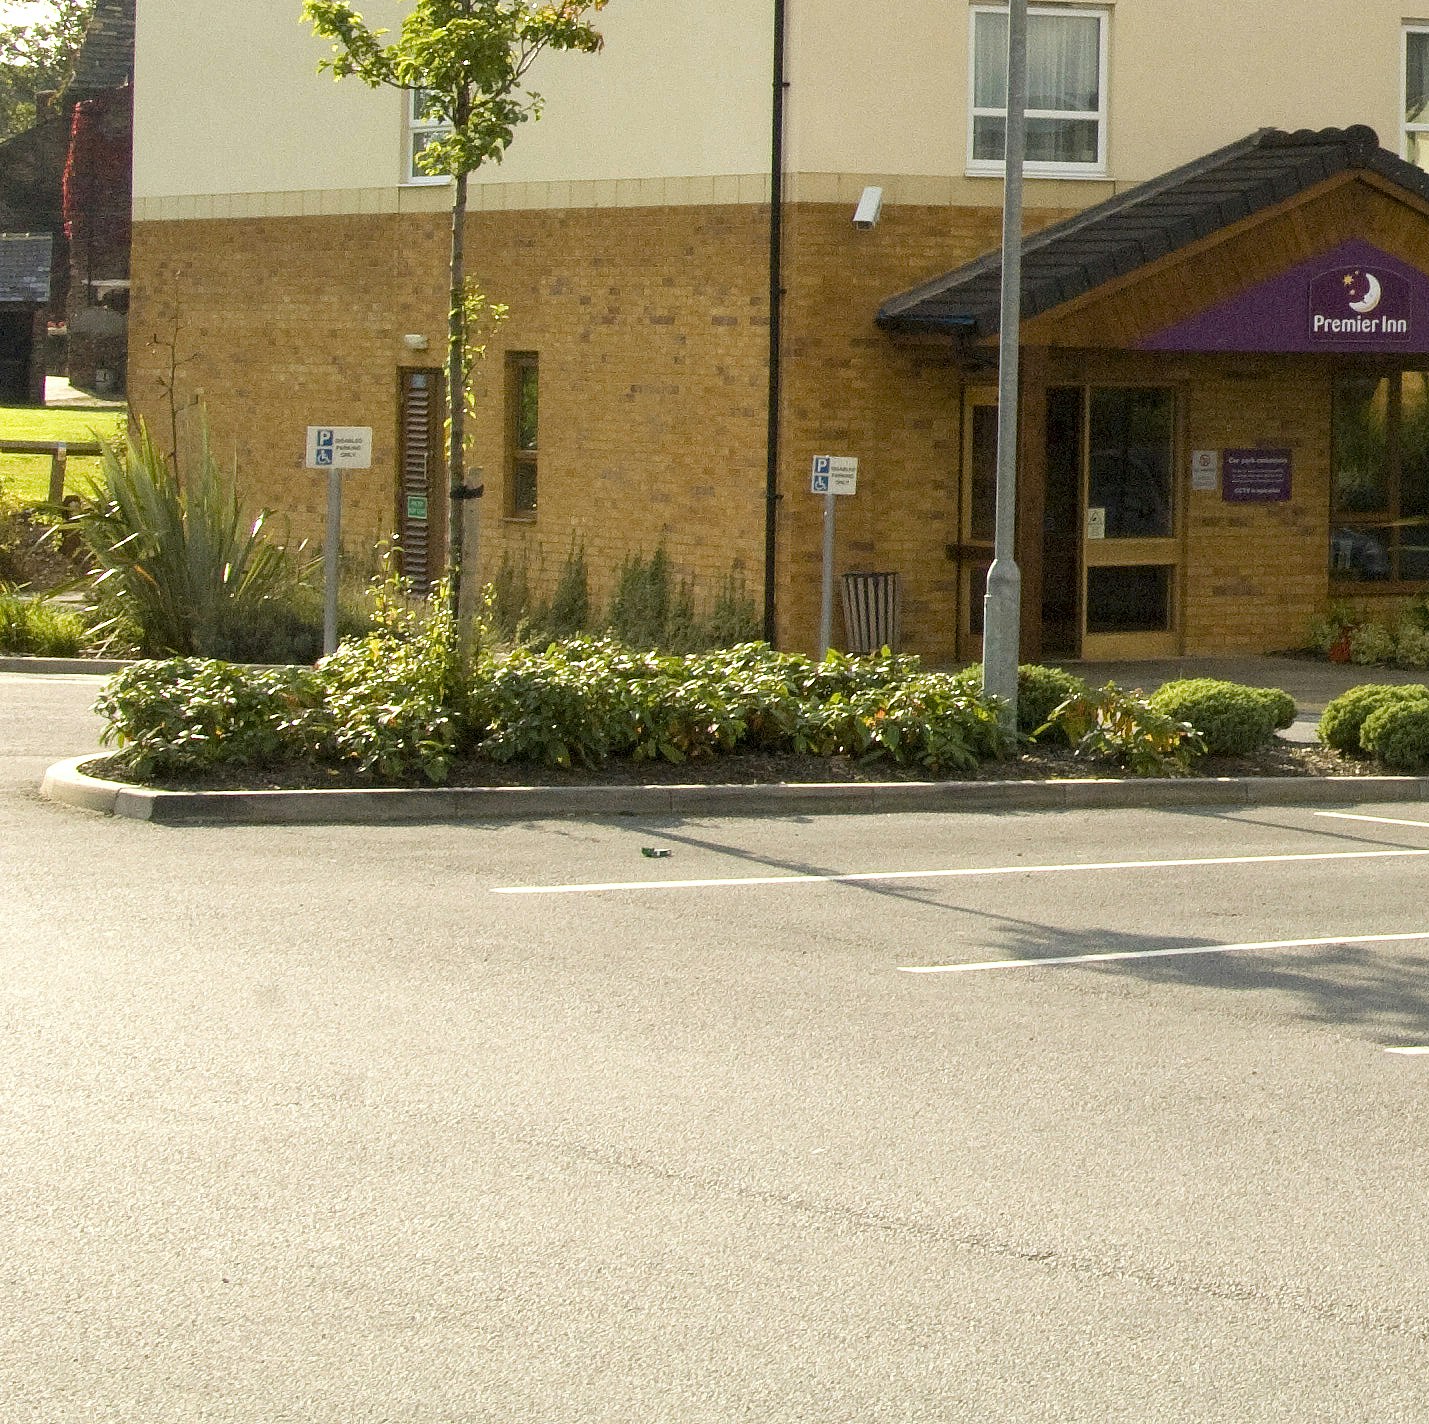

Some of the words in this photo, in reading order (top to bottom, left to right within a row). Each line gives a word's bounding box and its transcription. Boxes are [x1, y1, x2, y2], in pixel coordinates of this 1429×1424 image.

[1313, 314, 1379, 333] Premier
[1382, 315, 1407, 333] Inn
[320, 431, 330, 446] P
[818, 459, 828, 472] P
